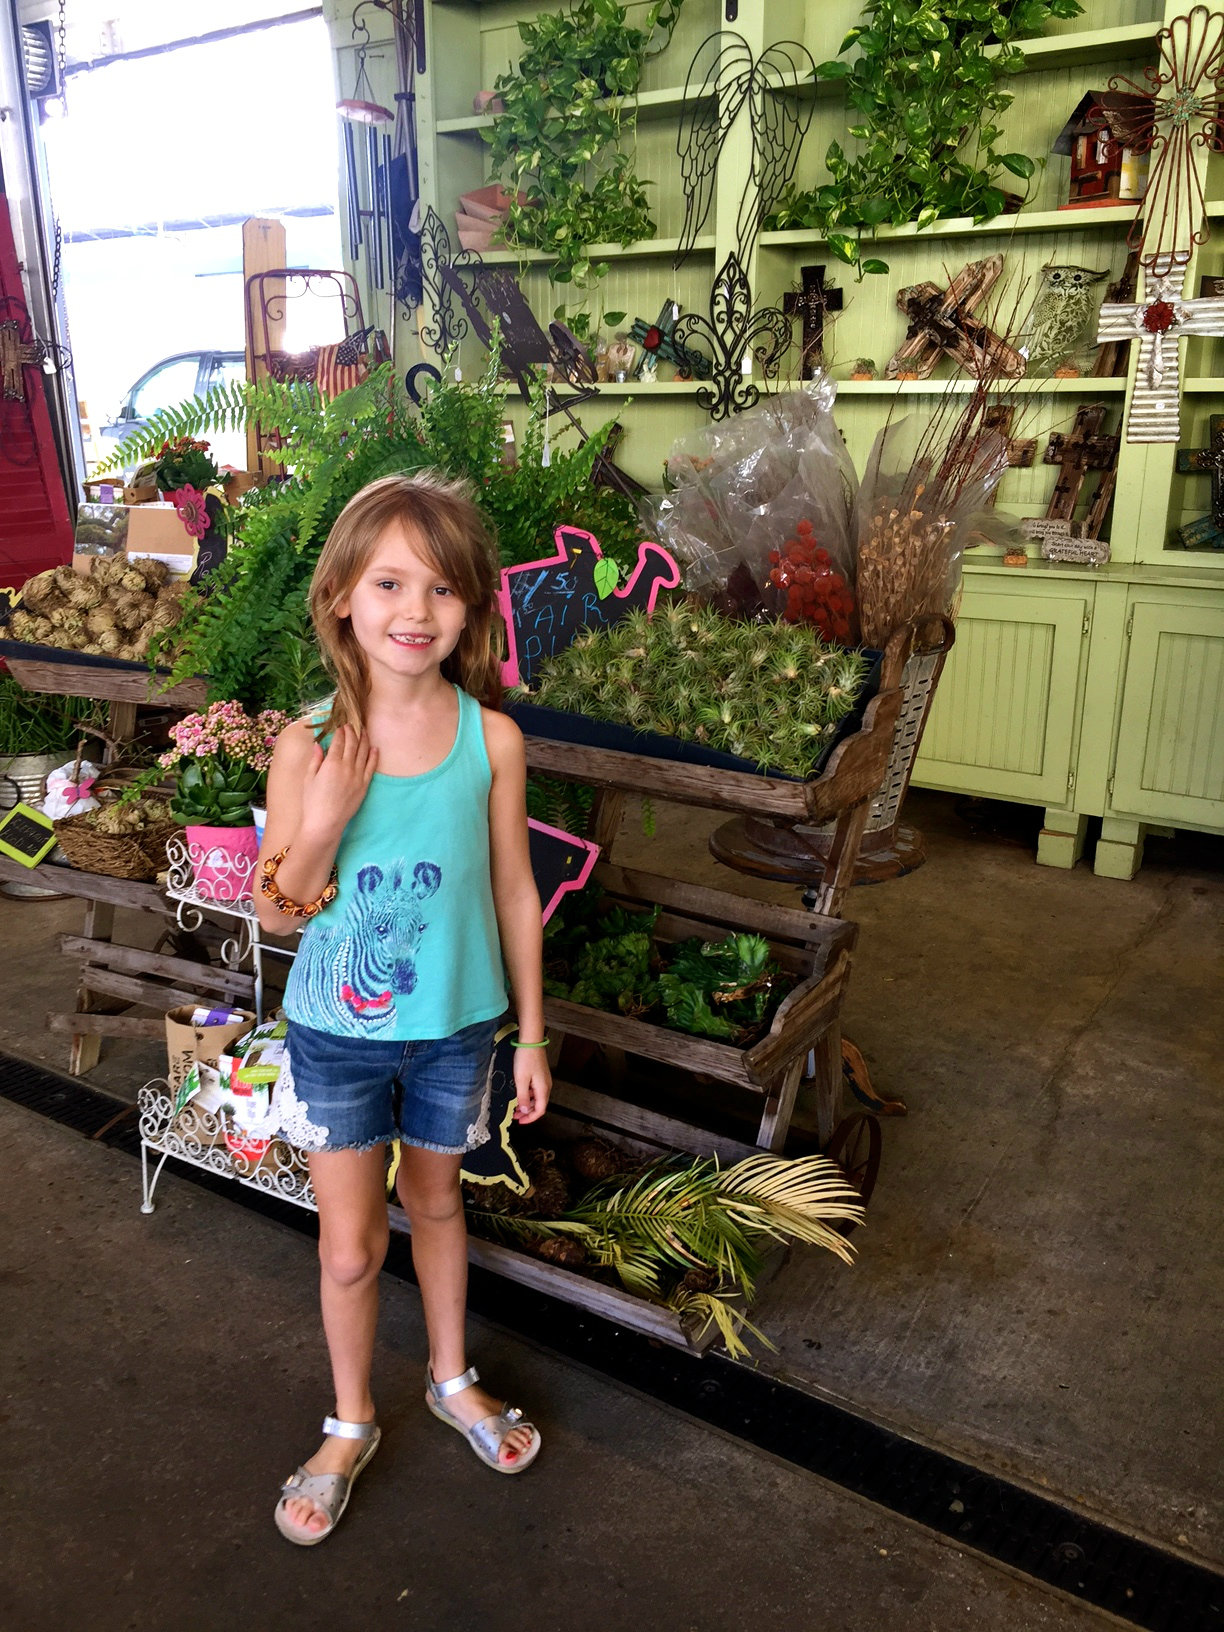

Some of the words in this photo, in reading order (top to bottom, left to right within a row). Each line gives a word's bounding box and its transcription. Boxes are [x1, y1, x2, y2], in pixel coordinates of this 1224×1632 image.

[1049, 548, 1079, 556] GRATEFUL
[1080, 549, 1099, 557] HEART
[535, 592, 609, 634] AIR
